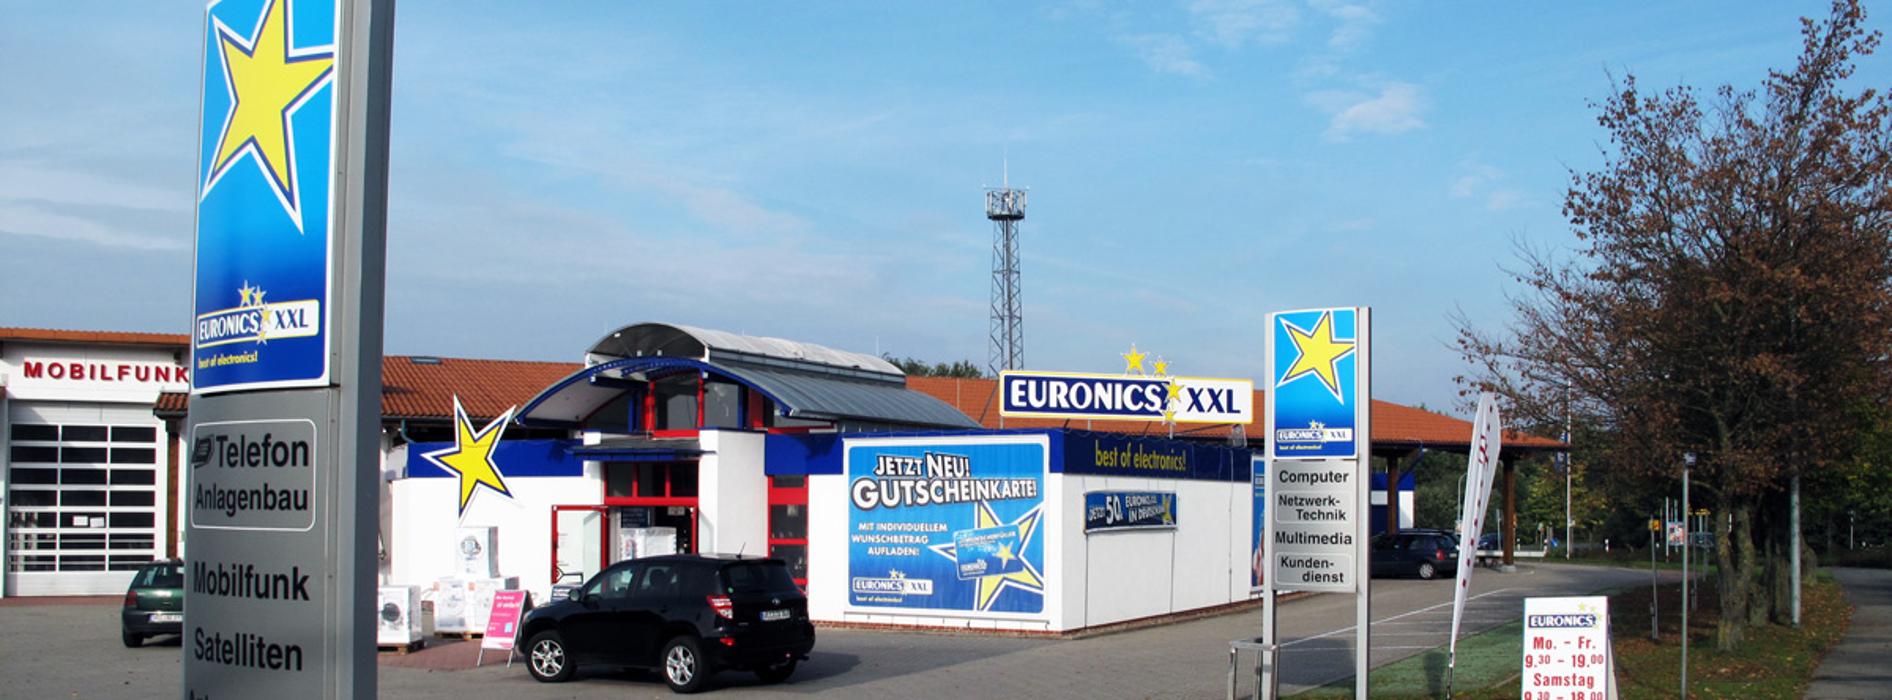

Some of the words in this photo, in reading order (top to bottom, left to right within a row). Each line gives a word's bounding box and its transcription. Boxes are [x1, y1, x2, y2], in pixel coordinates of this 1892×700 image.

[199, 311, 260, 340] EURONICS
[275, 308, 309, 330] XXL
[23, 361, 189, 383] MOBILFUNK
[1011, 379, 1162, 411] EURONICS
[1186, 387, 1241, 414] XXL
[216, 433, 309, 468] Telefon
[1095, 440, 1119, 467] best
[1120, 442, 1132, 468] of
[1133, 443, 1186, 471] electronics!
[875, 455, 922, 476] JETZT
[925, 453, 970, 477] NEU!
[1279, 469, 1349, 486] Computer
[195, 482, 308, 517] Anlagenbau
[852, 478, 1037, 510] GUTSCHEINKARTE!
[1278, 494, 1341, 507] Netzwerk-
[1296, 508, 1347, 521] Technik
[859, 522, 875, 531] MIT
[876, 522, 948, 532] INDIVIDUELLEM
[851, 534, 929, 544] WUNSCHBETRAG
[1275, 531, 1352, 545] Multimedia
[1281, 556, 1335, 569] Kunden-
[194, 562, 310, 601] Mobilfunk
[1302, 571, 1344, 583] dienst
[856, 580, 902, 591] EURONICS
[911, 582, 928, 592] XXL
[1530, 615, 1594, 627] EURONICS
[194, 627, 302, 672] Satelliten
[1533, 636, 1557, 650] Mo.
[1578, 636, 1596, 650] Fr.
[1525, 654, 1551, 668] 9.30
[1571, 654, 1604, 668] 19.00
[1533, 673, 1594, 689] Samstag
[1571, 691, 1603, 700] 1800
